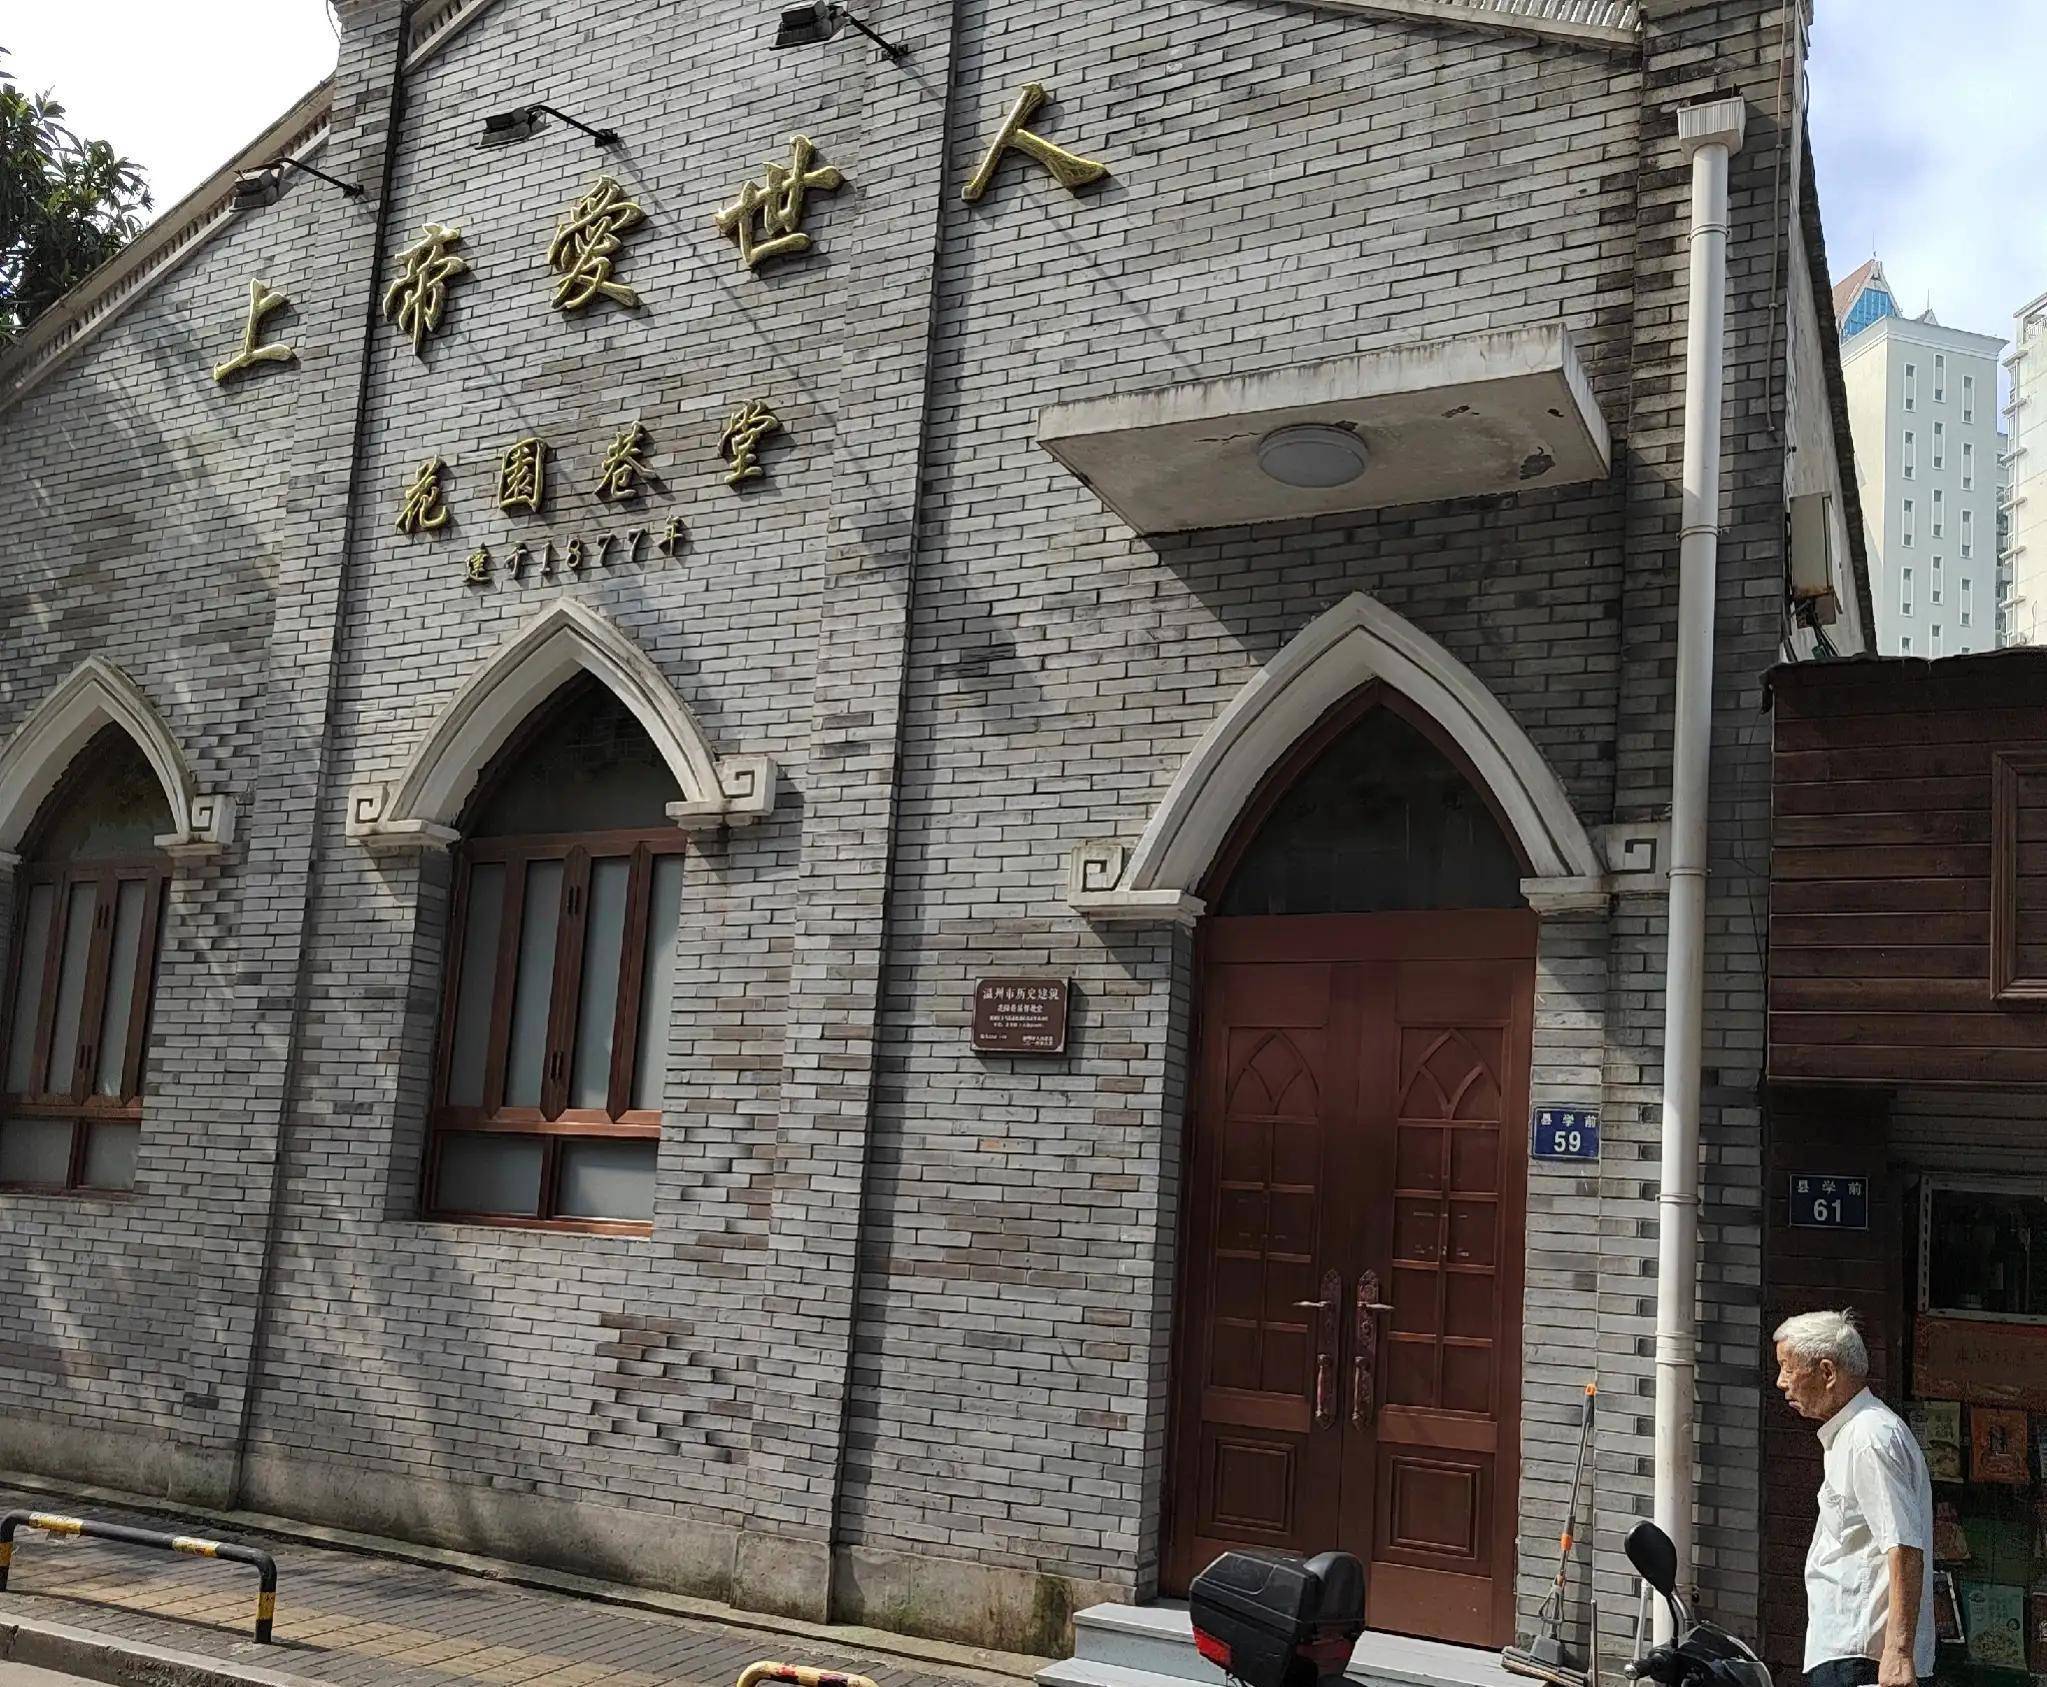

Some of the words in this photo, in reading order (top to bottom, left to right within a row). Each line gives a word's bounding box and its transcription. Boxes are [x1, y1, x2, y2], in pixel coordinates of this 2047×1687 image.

[396, 400, 782, 533] 花園巷堂
[1541, 1112, 1597, 1128] 县学前
[1553, 1131, 1582, 1153] 59
[1797, 1179, 1864, 1195] 县学前
[1812, 1199, 1843, 1222] 61
